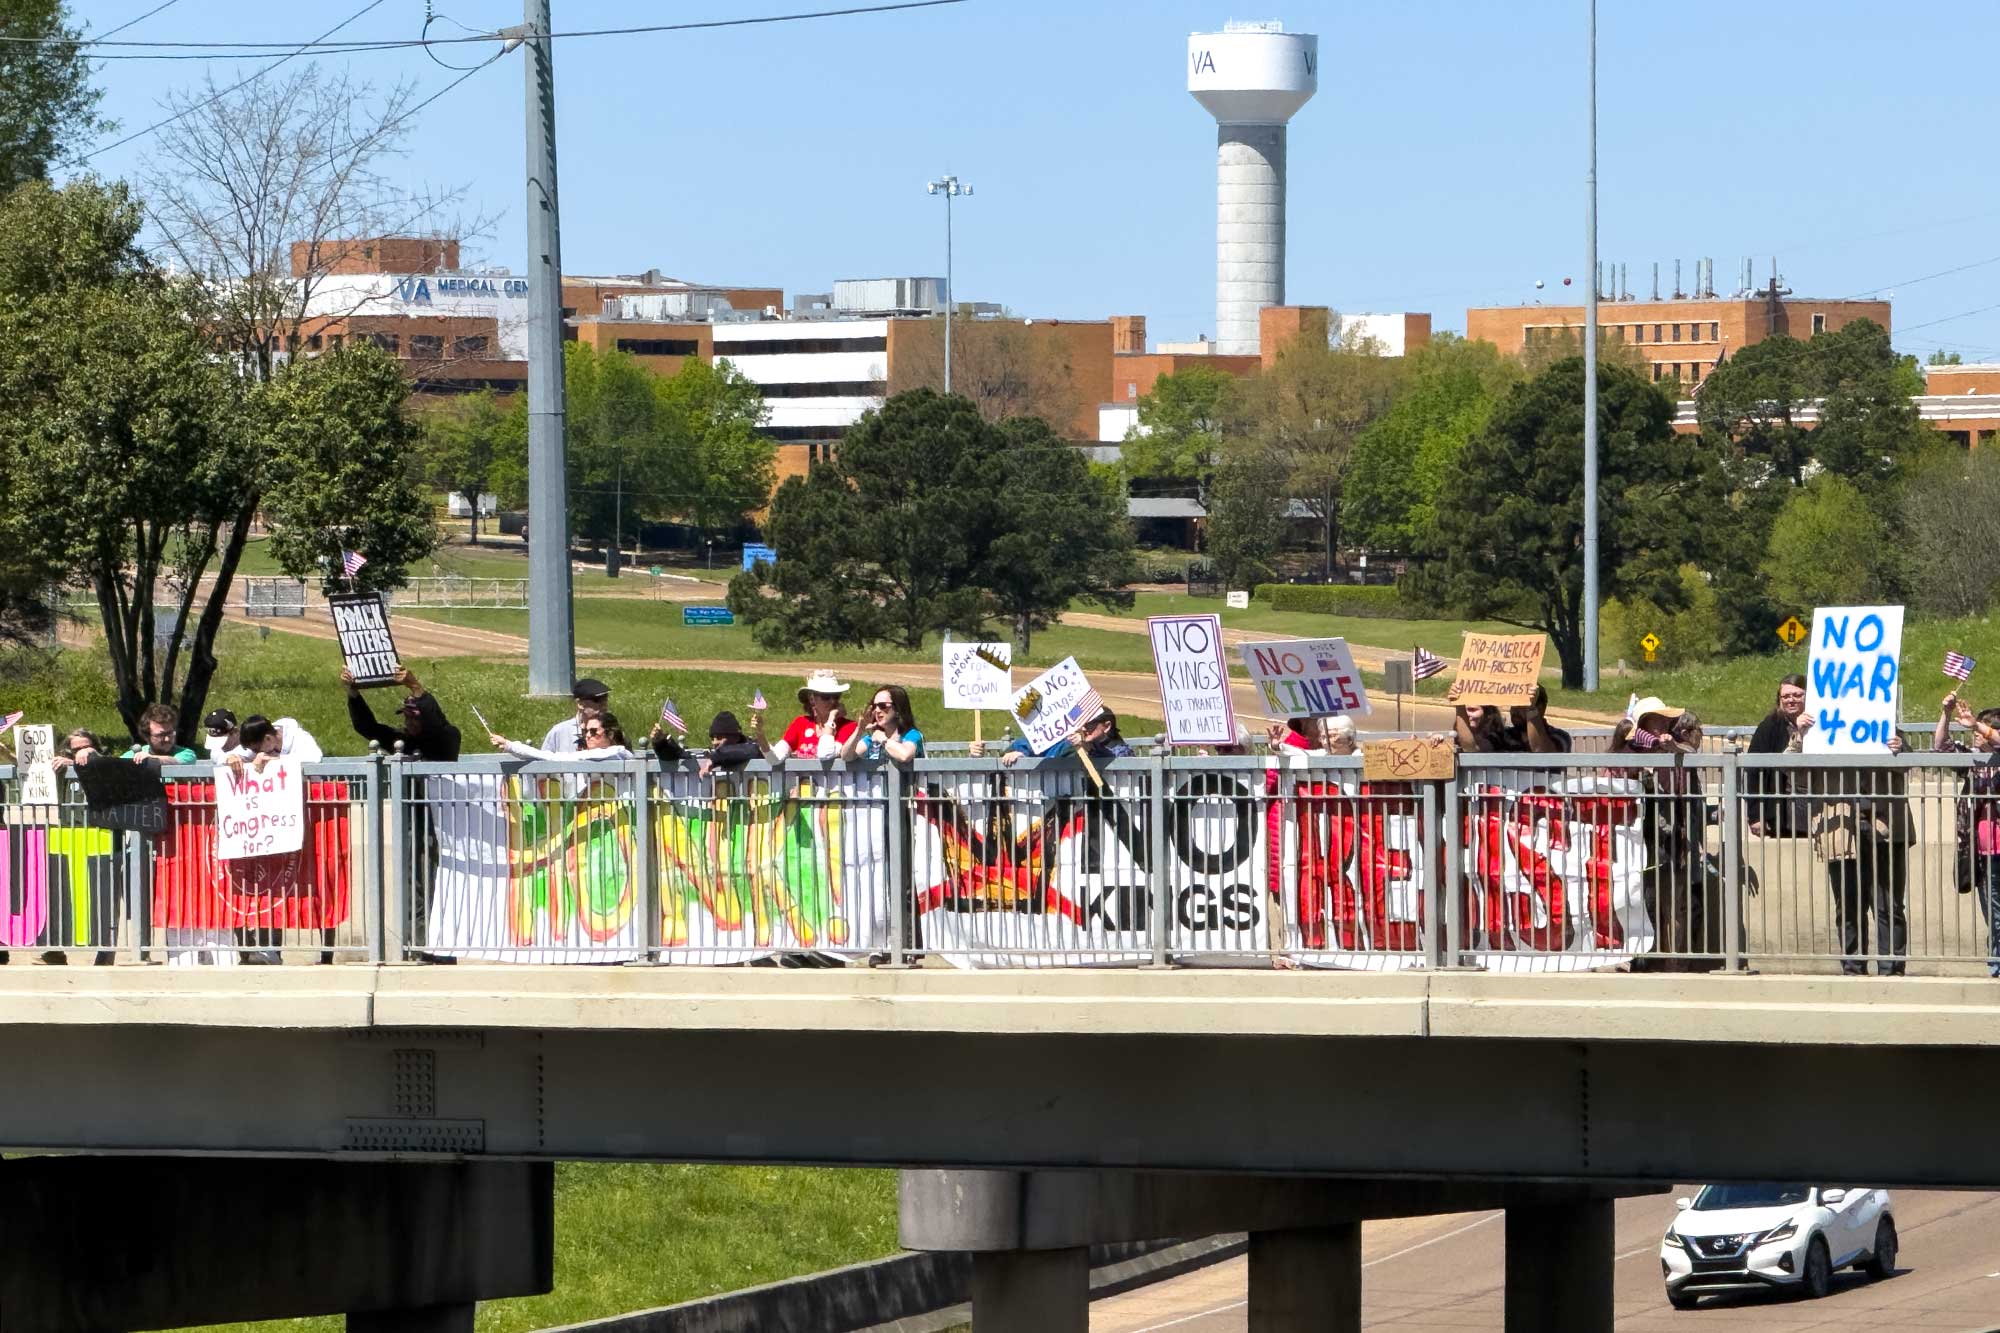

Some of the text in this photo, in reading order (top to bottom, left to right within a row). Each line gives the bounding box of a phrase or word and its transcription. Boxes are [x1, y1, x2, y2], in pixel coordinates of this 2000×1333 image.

[1192, 50, 1216, 74] VA
[397, 278, 433, 304] VA
[437, 279, 497, 292] MEDICAL
[340, 629, 392, 655] VOTERS
[1163, 622, 1209, 654] NO
[1823, 614, 1884, 652] NO
[949, 652, 960, 669] NO
[1469, 638, 1541, 659] PRO-AMERICA
[345, 652, 397, 678] MATTER
[951, 647, 976, 685] CROWN
[1166, 660, 1221, 690] KINGS
[1813, 653, 1896, 703] WAR
[958, 682, 998, 697] CLOWN
[1261, 676, 1360, 714] KINGS
[1168, 696, 1223, 712] NO TYRANTS
[1043, 714, 1075, 742] USA
[1179, 715, 1223, 734] NO HATE
[1819, 708, 1846, 745] 4
[23, 730, 46, 746] GOD
[24, 750, 45, 764] SAVE
[31, 771, 45, 784] THE
[226, 765, 288, 797] What
[28, 786, 49, 799] KING
[246, 796, 259, 811] is
[223, 813, 297, 839] Congress
[1081, 774, 1258, 875] NO
[243, 835, 275, 856] for?
